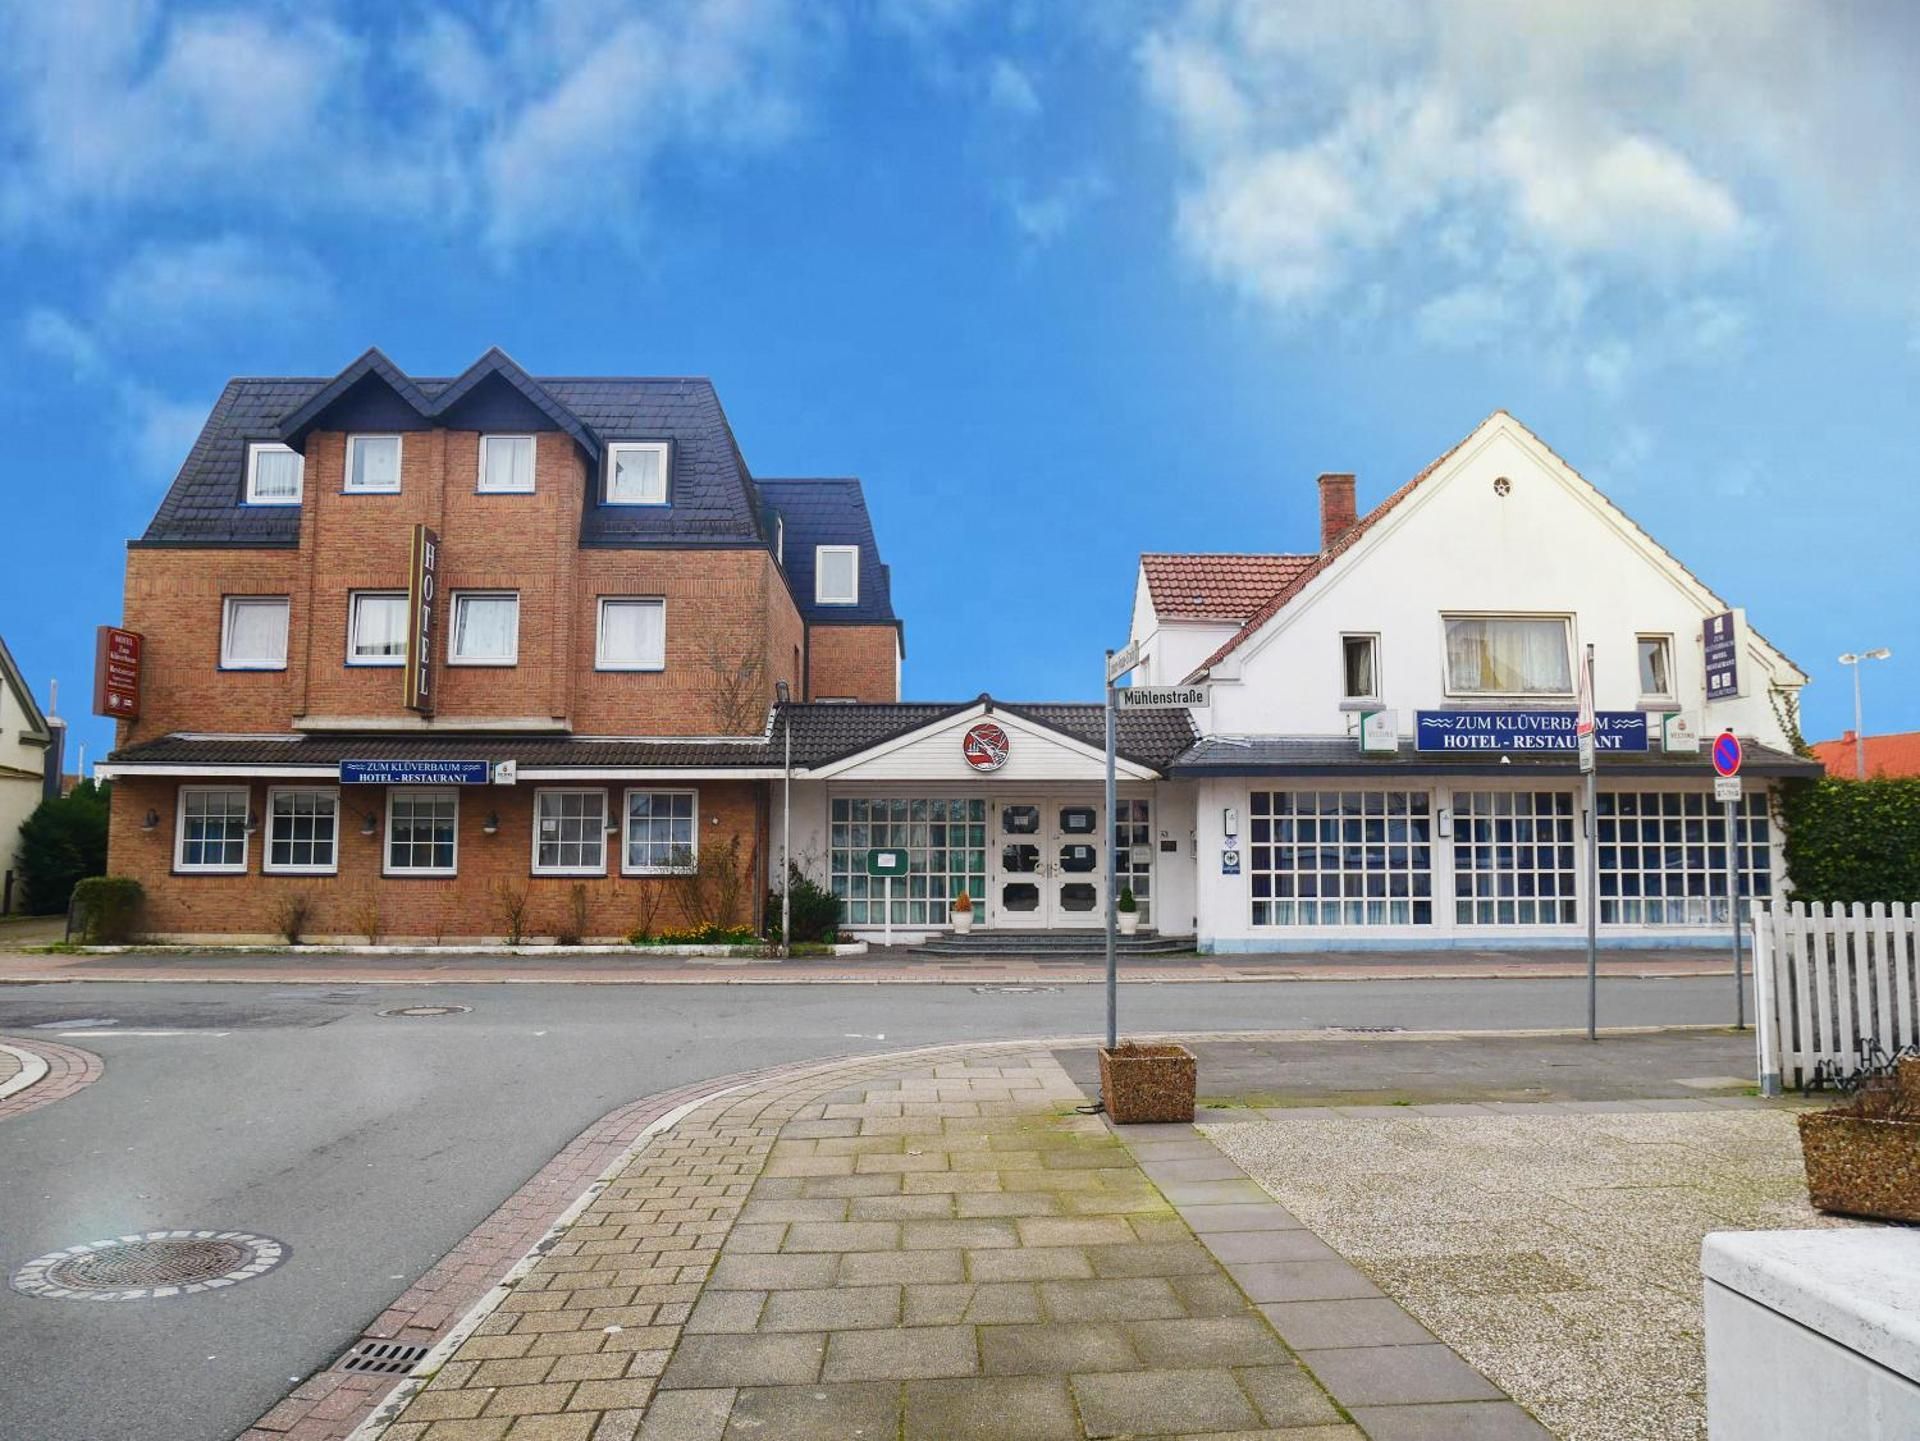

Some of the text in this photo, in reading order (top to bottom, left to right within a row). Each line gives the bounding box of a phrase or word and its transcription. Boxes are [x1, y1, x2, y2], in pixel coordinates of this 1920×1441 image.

[420, 541, 435, 696] HOTEL
[1124, 689, 1203, 705] Mühlenstraße
[1455, 714, 1609, 730] ZUM KLÜVERBAM
[1444, 735, 1501, 748] HOTEL
[367, 762, 460, 772] ZUM KLÜVERBAUM
[359, 773, 395, 783] HOTEL
[401, 773, 468, 783] RESTAURANT
